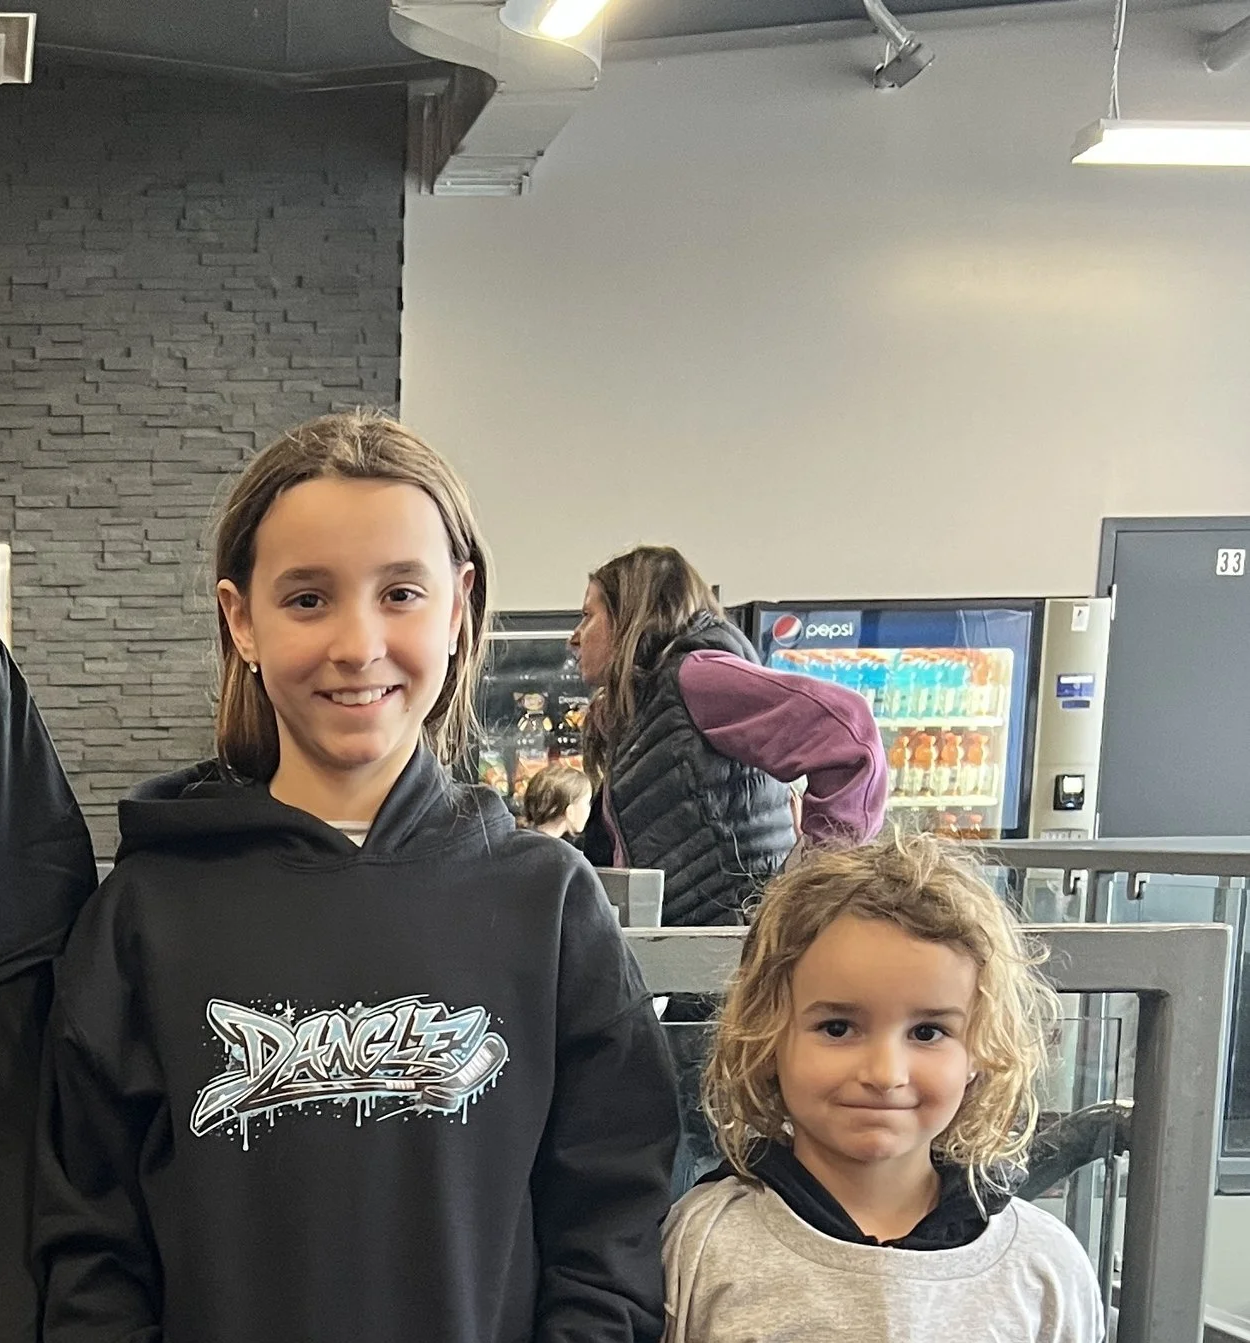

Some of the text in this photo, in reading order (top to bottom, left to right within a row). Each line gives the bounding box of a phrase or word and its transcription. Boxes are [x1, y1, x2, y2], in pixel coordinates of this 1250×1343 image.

[1220, 551, 1242, 573] 33
[805, 621, 853, 640] pepsi
[205, 999, 489, 1098] DANGLE
